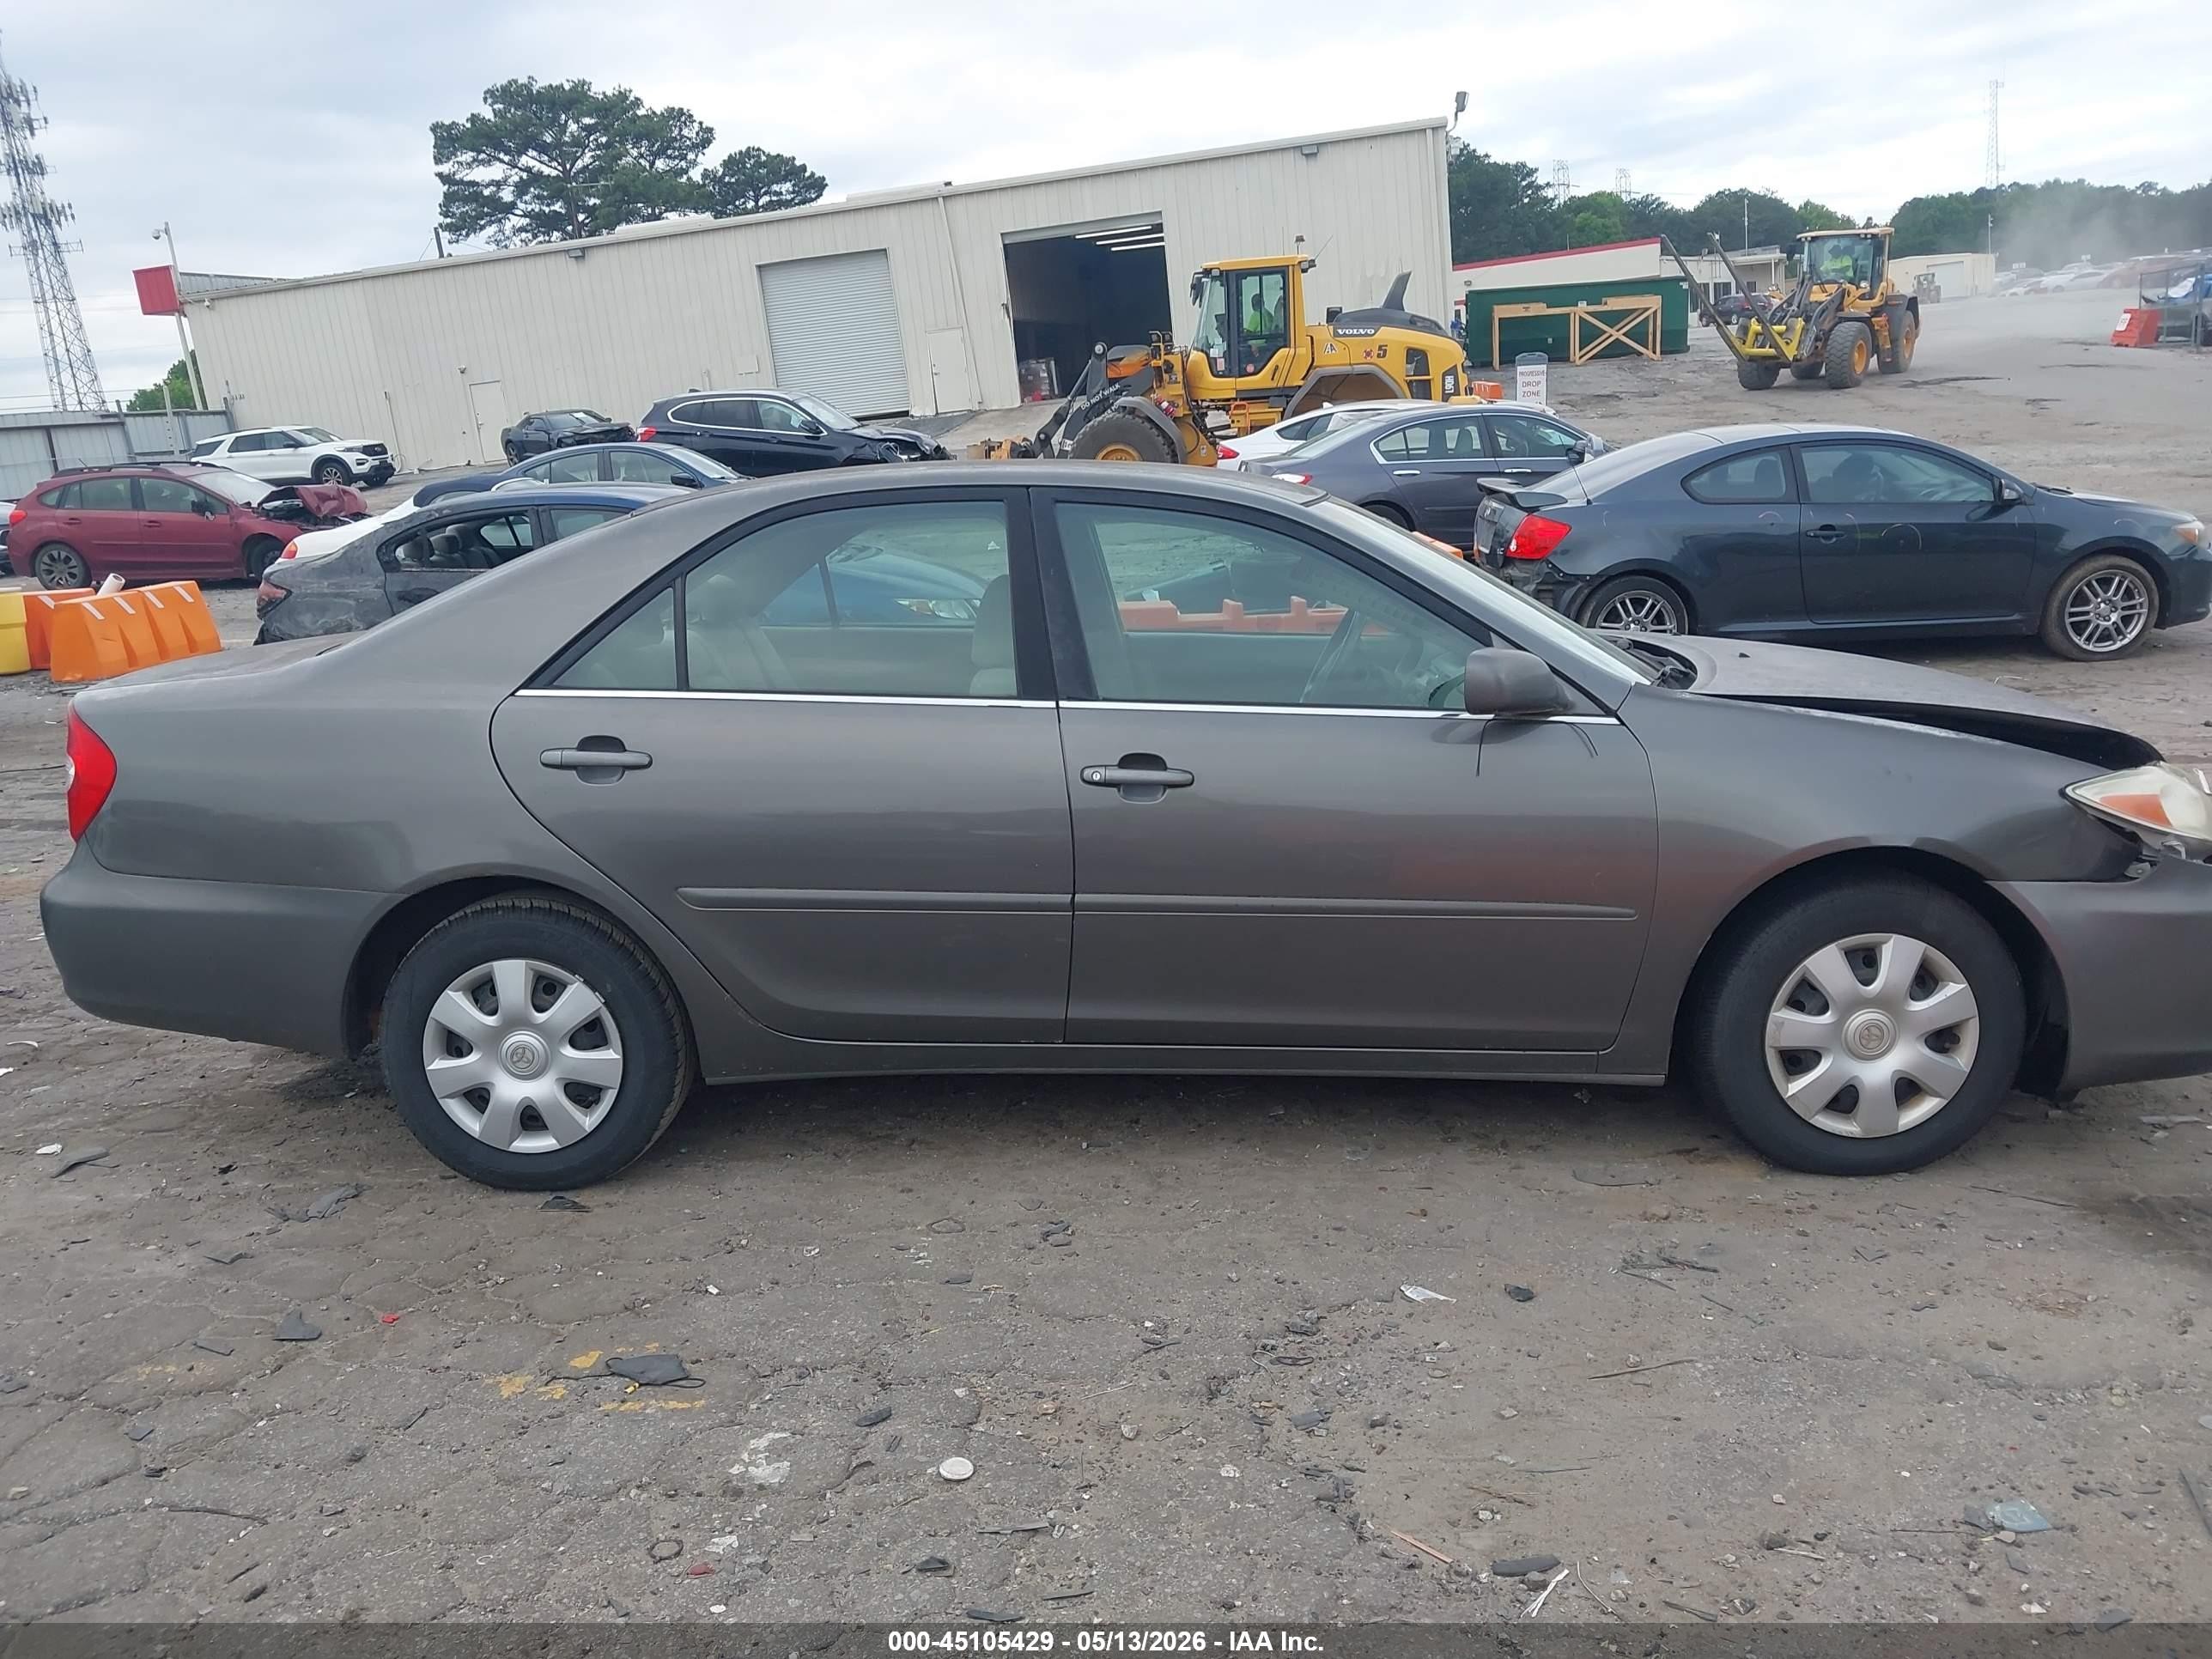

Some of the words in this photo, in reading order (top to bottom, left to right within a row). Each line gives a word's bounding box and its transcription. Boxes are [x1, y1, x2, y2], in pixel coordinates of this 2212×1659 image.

[1376, 343, 1388, 359] 5
[1444, 375, 1455, 393] L90H
[1080, 401, 1091, 410] DO
[1103, 382, 1121, 396] WALK
